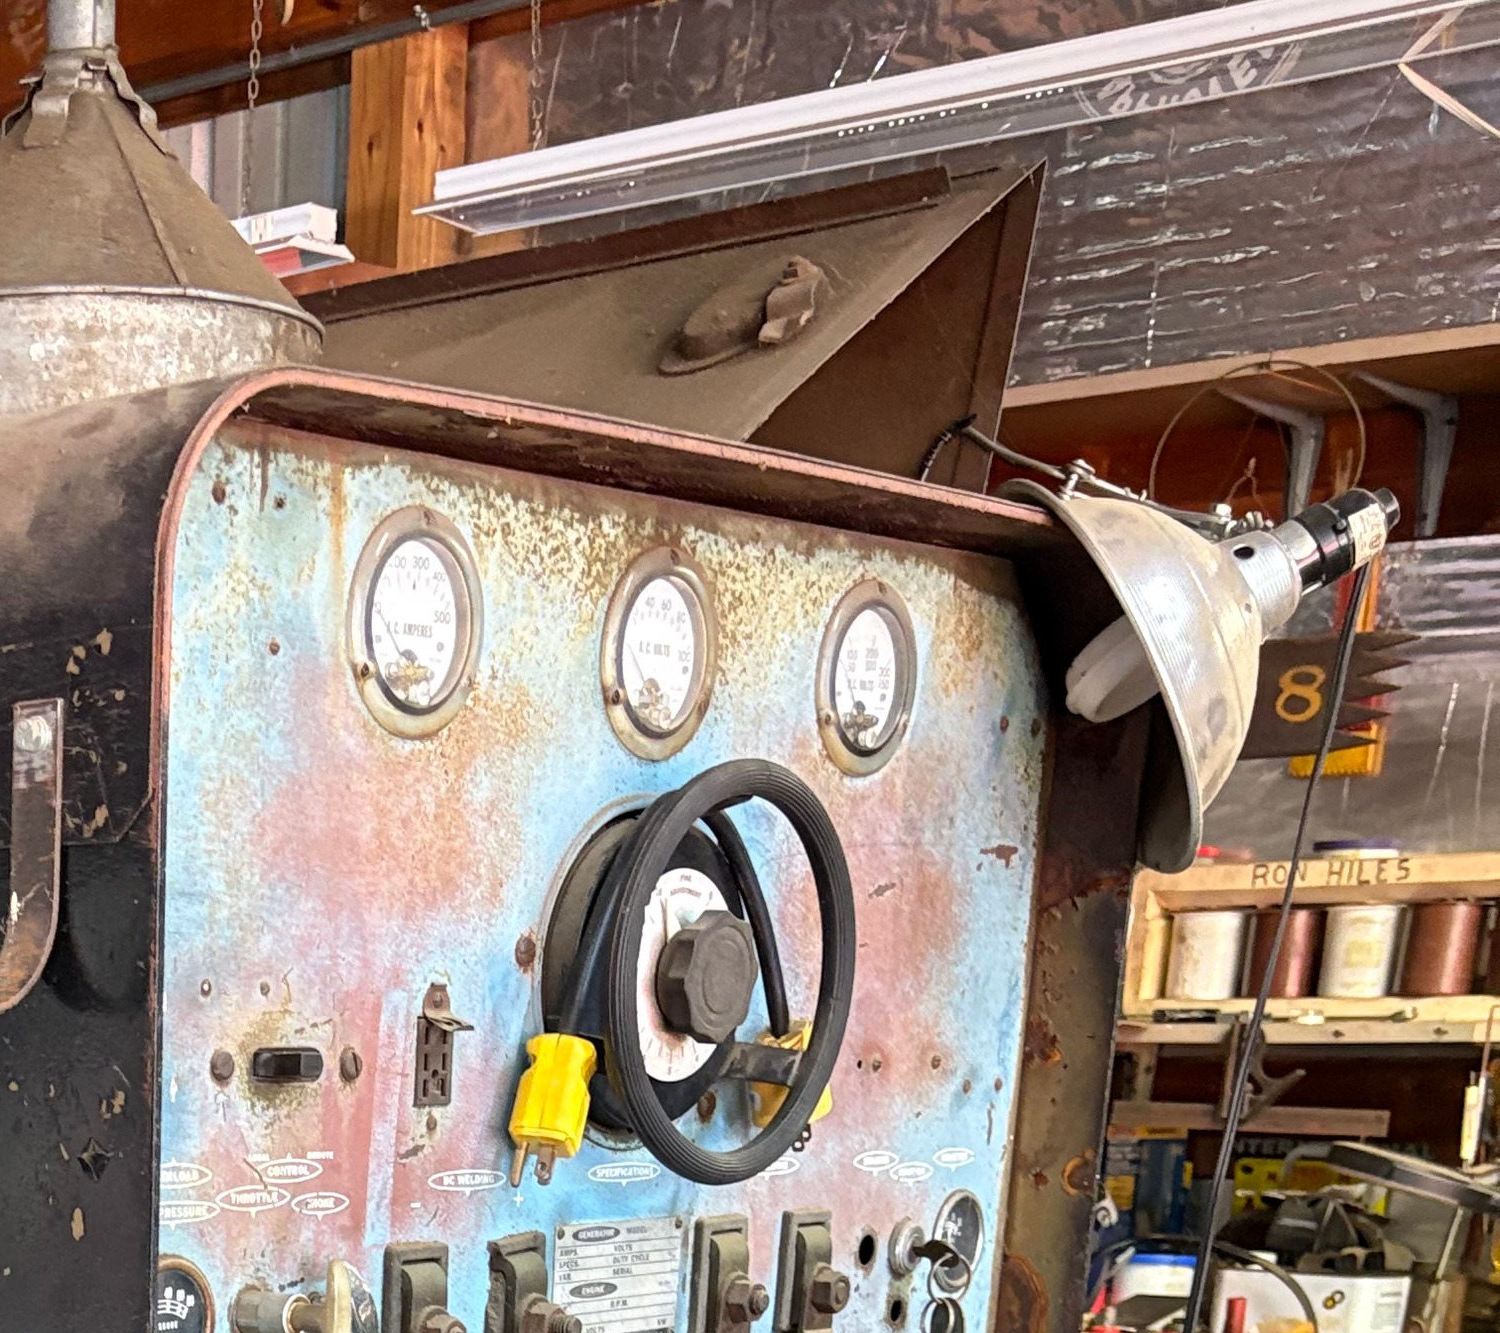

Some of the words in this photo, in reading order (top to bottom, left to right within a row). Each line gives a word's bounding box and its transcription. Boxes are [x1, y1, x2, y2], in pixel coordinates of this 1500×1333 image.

[412, 556, 430, 570] 300
[432, 571, 446, 583] 400
[661, 599, 672, 611] 60
[434, 611, 451, 624] 500
[402, 623, 434, 638] AMPERES
[1275, 665, 1326, 723] 8
[1252, 864, 1308, 889] RON
[1327, 858, 1411, 886] HILES
[267, 1165, 310, 1177] CONTROL
[457, 1173, 495, 1185] WELDING
[231, 1192, 279, 1204] THROTTLE
[578, 1228, 616, 1239] GENERATOR
[626, 1226, 648, 1234] MODEL
[614, 1244, 633, 1252] VOLTS
[613, 1268, 633, 1276] SERIAL
